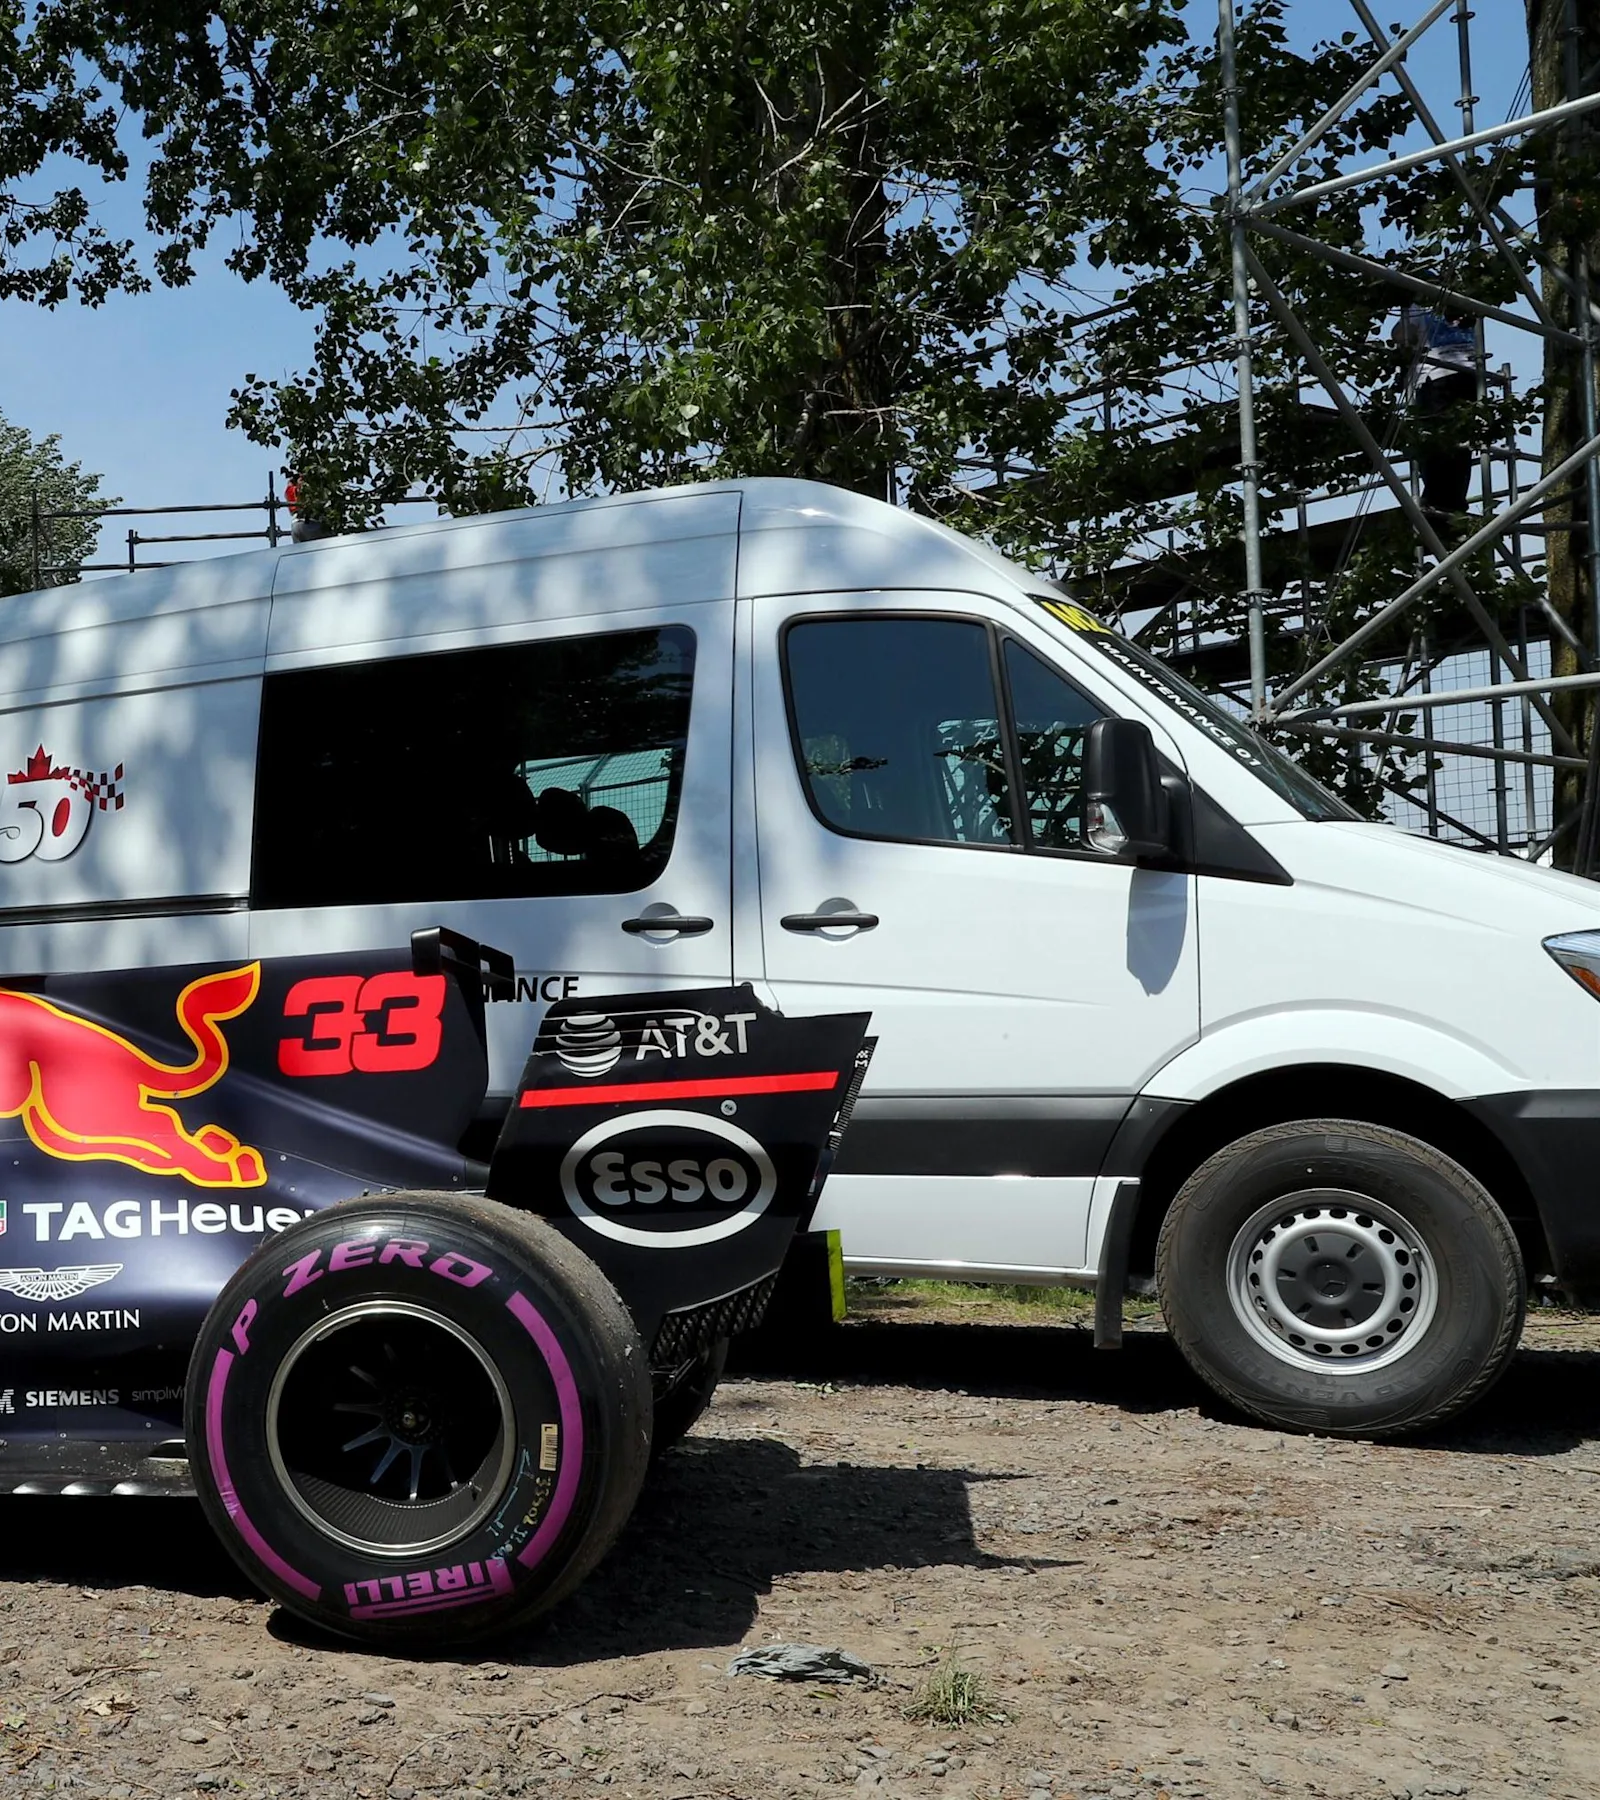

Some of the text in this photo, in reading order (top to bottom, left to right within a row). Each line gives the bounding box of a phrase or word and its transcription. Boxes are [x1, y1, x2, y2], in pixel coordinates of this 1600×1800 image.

[1096, 640, 1263, 767] MAINTENANCE 01
[277, 972, 447, 1077] 33
[634, 1012, 757, 1061] AT&T
[20, 1272, 79, 1283] ASTON MARTIN
[231, 1237, 495, 1355] P ZERO
[47, 1308, 141, 1331] MARTIN
[25, 1387, 120, 1407] SIEMENS
[343, 1558, 516, 1621] PIRELLI
